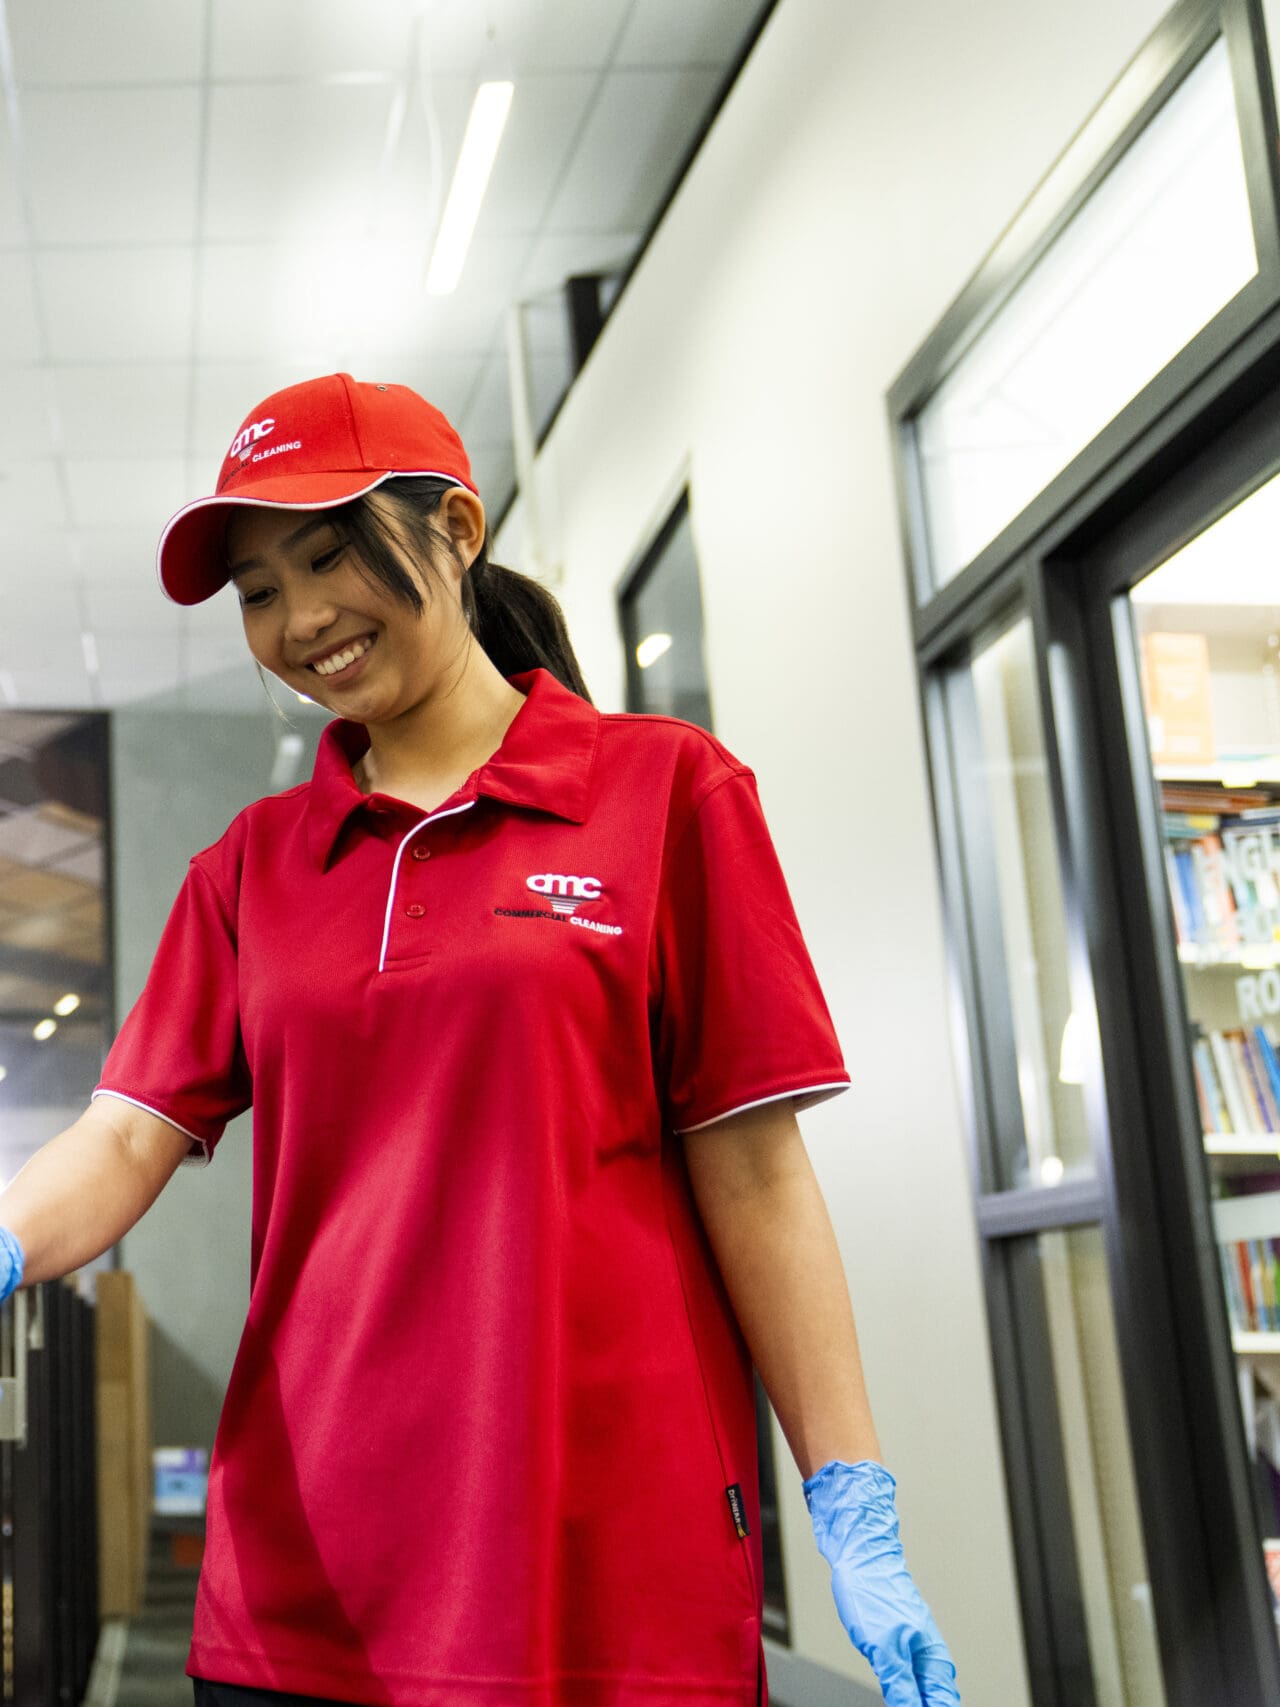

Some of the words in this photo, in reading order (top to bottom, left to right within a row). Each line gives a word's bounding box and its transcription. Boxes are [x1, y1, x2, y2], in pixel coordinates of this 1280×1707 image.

[252, 441, 302, 462] CLEANING
[494, 907, 567, 922] COMMERCIAL
[569, 916, 623, 935] CLEANING
